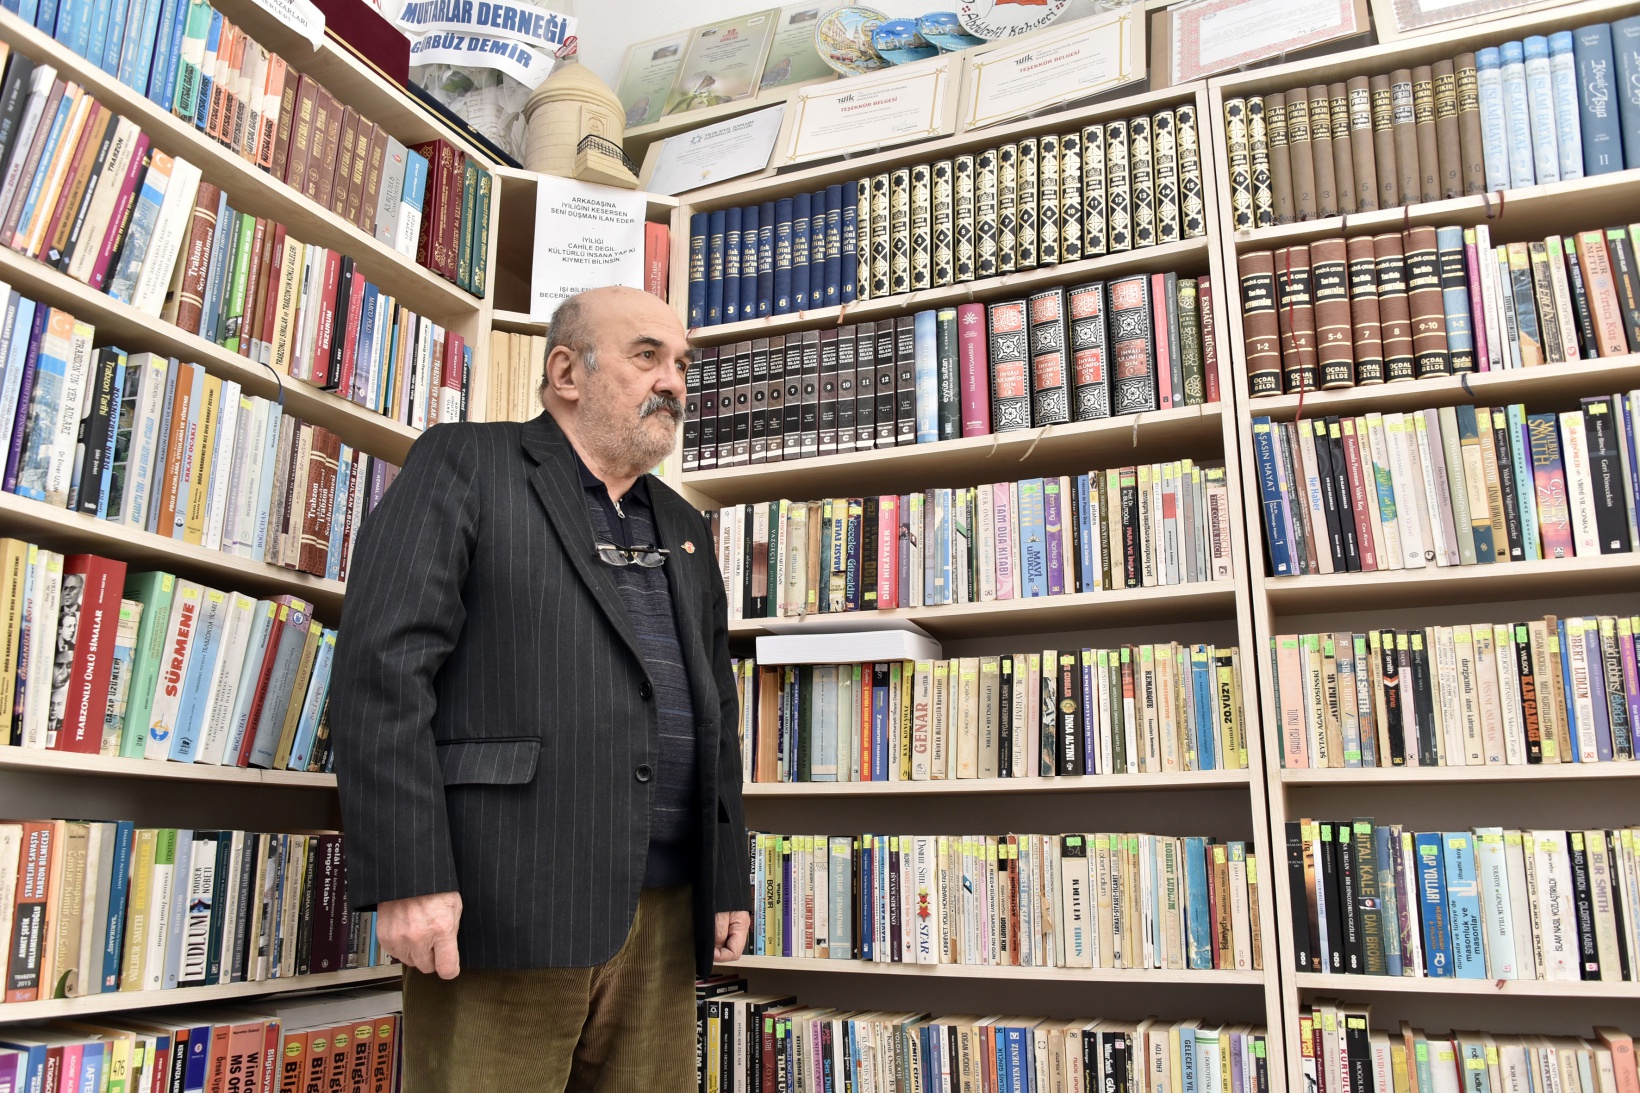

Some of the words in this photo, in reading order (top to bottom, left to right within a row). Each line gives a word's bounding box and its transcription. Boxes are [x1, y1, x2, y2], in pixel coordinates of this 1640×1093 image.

[400, 0, 473, 25] MUHTARLAR
[477, 1, 568, 46] DERNEĞİ
[466, 37, 533, 68] DEMİR
[1019, 59, 1053, 73] TEŞEKKÜR
[1053, 50, 1081, 64] BELGESİ
[840, 102, 873, 113] TEŞEKKÜR
[874, 97, 898, 107] BELGESİ
[107, 137, 124, 173] TRABZON
[550, 208, 566, 216] SENİ
[567, 209, 598, 220] DÜŞMAN
[598, 214, 615, 223] İLAN
[561, 201, 590, 212] İYİLİĞİNİ
[591, 206, 628, 218] KESERSEN
[571, 197, 617, 209] ARKADAŞINA
[548, 247, 585, 257] KÜLTÜRLÜ
[586, 250, 613, 258] İNSANA
[567, 242, 593, 251] CAHİLE
[582, 236, 604, 245] İYİLİĞİ
[189, 239, 203, 278] Trabzon
[562, 256, 590, 264] KIYMETİ
[559, 285, 569, 293] İŞİ
[843, 284, 852, 293] 10
[322, 310, 333, 350] ERZURUM
[1327, 332, 1343, 340] 5-6
[1419, 321, 1438, 330] 9-10
[1256, 342, 1270, 350] 1-2
[102, 360, 116, 393] Trabzon
[67, 387, 78, 403] YER
[99, 394, 110, 417] Tarihi
[61, 404, 75, 436] ADLARI
[106, 386, 120, 443] TRABZONSPOR
[187, 422, 197, 454] OCAKLI
[185, 455, 194, 483] ERKAN
[1264, 465, 1275, 492] HAYAT
[1310, 490, 1320, 511] Haber
[1538, 485, 1553, 525] ZAFERİ
[1550, 478, 1569, 530] GÜNEŞİN
[1602, 473, 1613, 508] Döneceksin
[997, 503, 1008, 520] TAM
[1217, 492, 1228, 522] MAEVE
[258, 510, 267, 548] BOĞAÇHAN
[997, 522, 1008, 539] DUA
[1219, 523, 1230, 558] BINCHY
[882, 529, 891, 577] HİKÂYELER
[998, 542, 1010, 578] KİTABI
[1027, 545, 1036, 584] UFUKLAR
[1033, 549, 1042, 574] MAVİ
[882, 579, 891, 601] DİNİ
[165, 602, 196, 698] SÜRMENE
[76, 699, 89, 741] TRABZONLU
[84, 671, 93, 698] ÜNLÜ
[89, 610, 103, 652] SİMALAR
[108, 656, 121, 696] ÜZÜMLERİ
[1342, 657, 1353, 687] TANRISI
[1522, 674, 1535, 695] KAN
[1144, 670, 1154, 709] REMARQUE
[105, 697, 113, 724] GAZAP
[1065, 714, 1075, 733] İNKA
[1525, 696, 1540, 742] ÇANAĞI
[914, 702, 929, 755] GENAR
[1065, 734, 1075, 761] ALTINI
[29, 831, 39, 861] SAVAŞTA
[39, 830, 50, 866] BİLMECESİ
[323, 843, 334, 876] şengör
[1165, 842, 1175, 874] ROBERT
[25, 863, 35, 898] STRATEJİK
[35, 867, 46, 899] TRABZON
[766, 879, 774, 909] BOZKIR
[889, 871, 897, 896] SAVAŞI
[1167, 877, 1176, 911] LUDLUM
[1360, 863, 1373, 896] KALE
[1424, 871, 1439, 904] YOLLARI
[21, 917, 31, 936] ŞEFİK
[28, 906, 42, 969] MOLLAMEHMETOĞLU
[919, 923, 931, 955] STAR
[1364, 914, 1377, 933] DAN
[1470, 916, 1480, 955] masonlar
[19, 937, 29, 959] AHMET
[185, 914, 209, 977] LUDLUM
[1366, 935, 1379, 973] BROWN
[1461, 920, 1474, 962] masonluk
[1184, 1039, 1193, 1070] GELECEK
